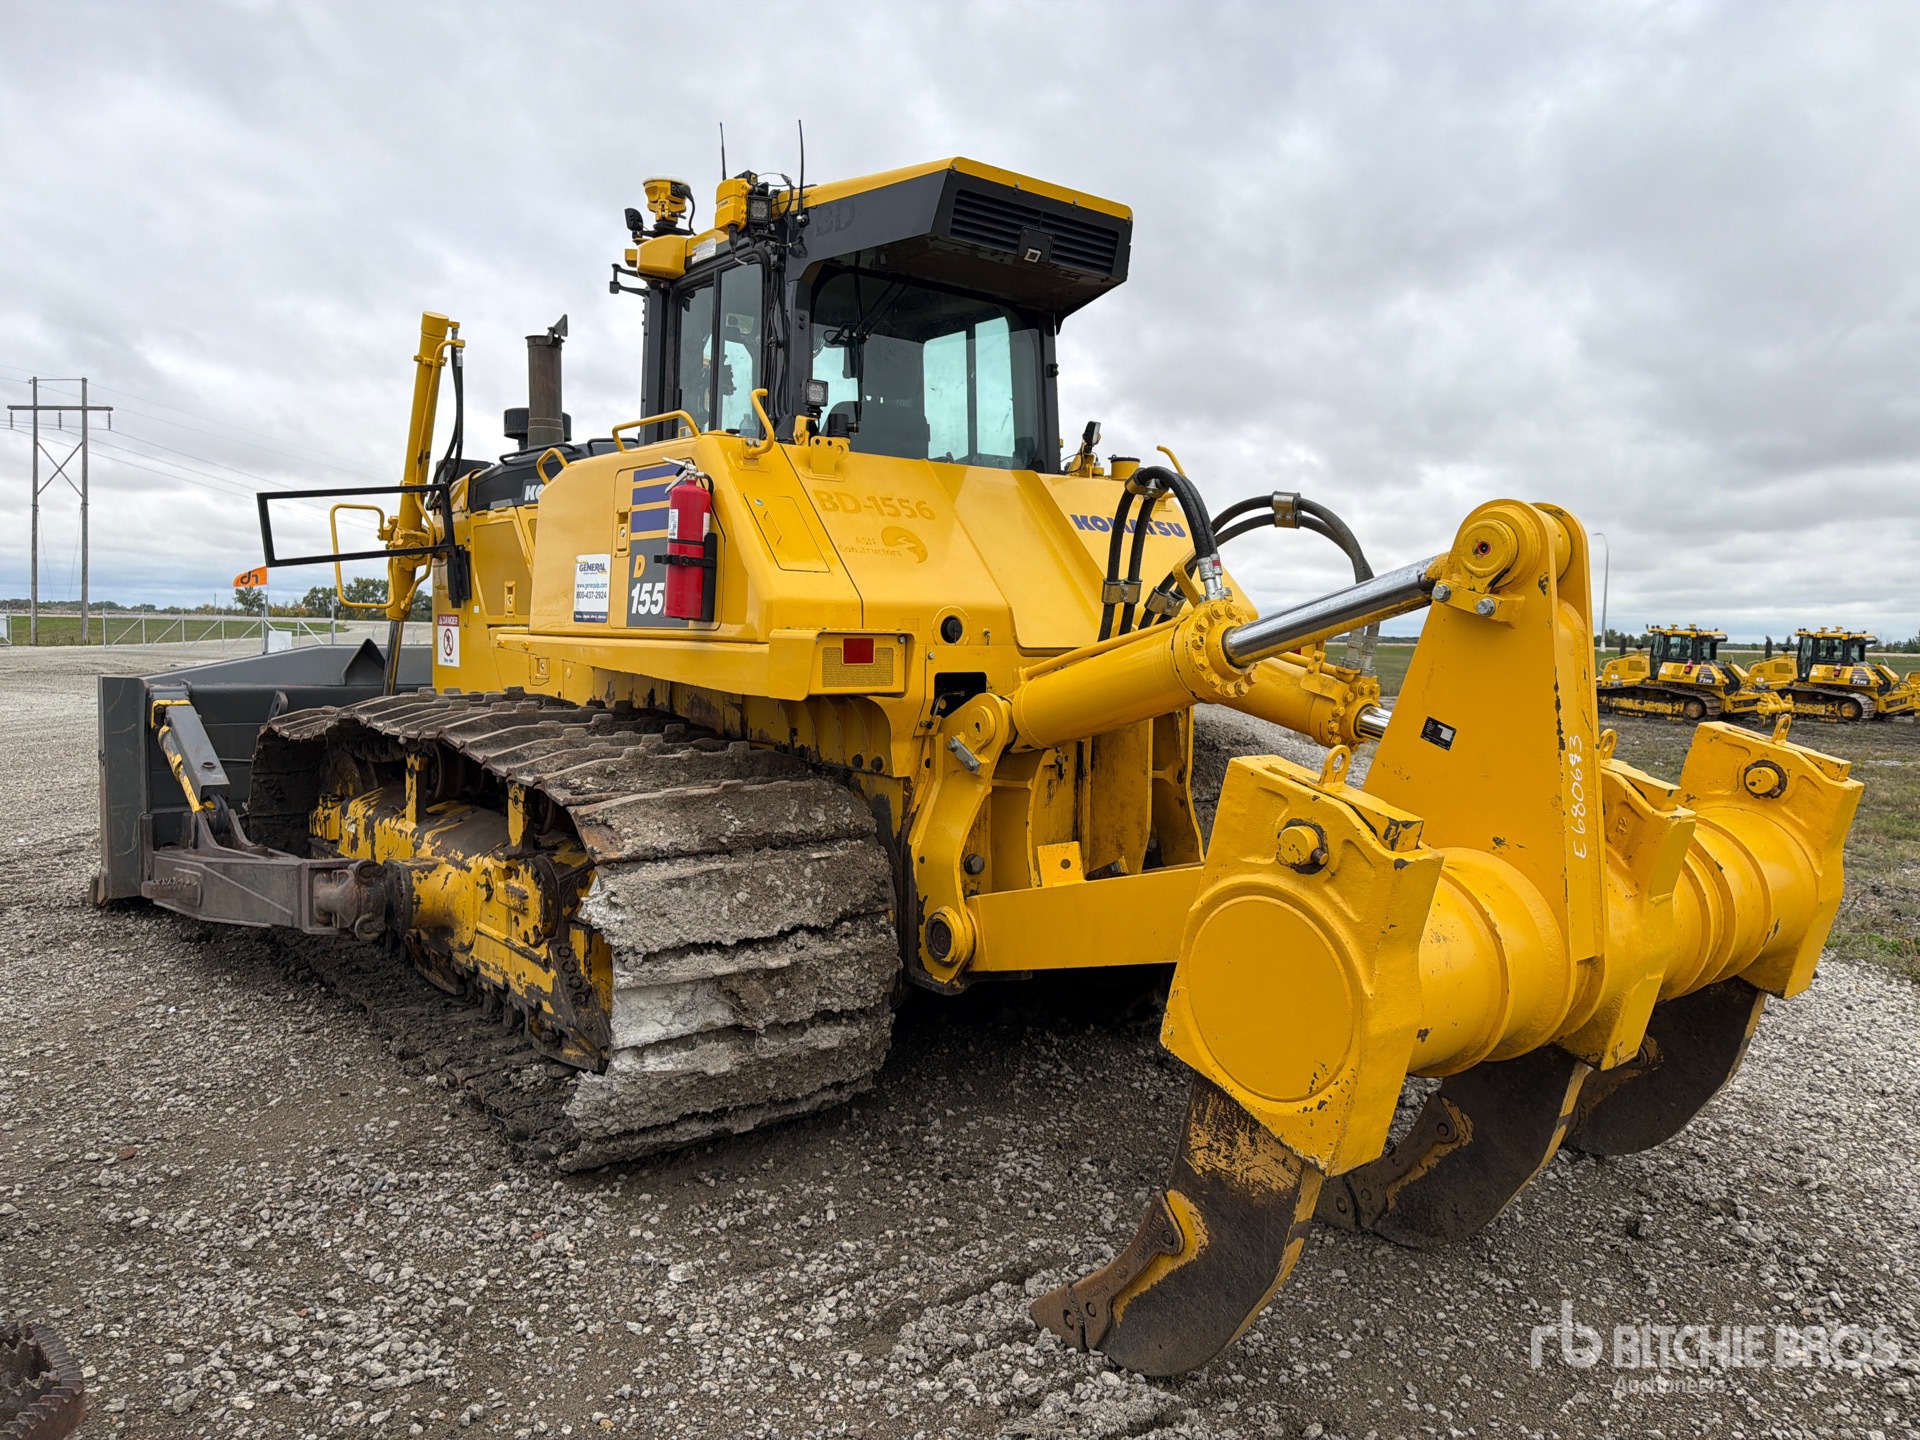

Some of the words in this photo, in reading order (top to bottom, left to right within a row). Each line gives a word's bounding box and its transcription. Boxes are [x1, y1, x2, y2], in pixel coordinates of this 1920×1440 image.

[813, 490, 936, 520] BD-1556
[579, 562, 607, 573] GENERAL
[633, 555, 646, 578] D
[631, 582, 665, 615] 155
[1573, 840, 1587, 858] E
